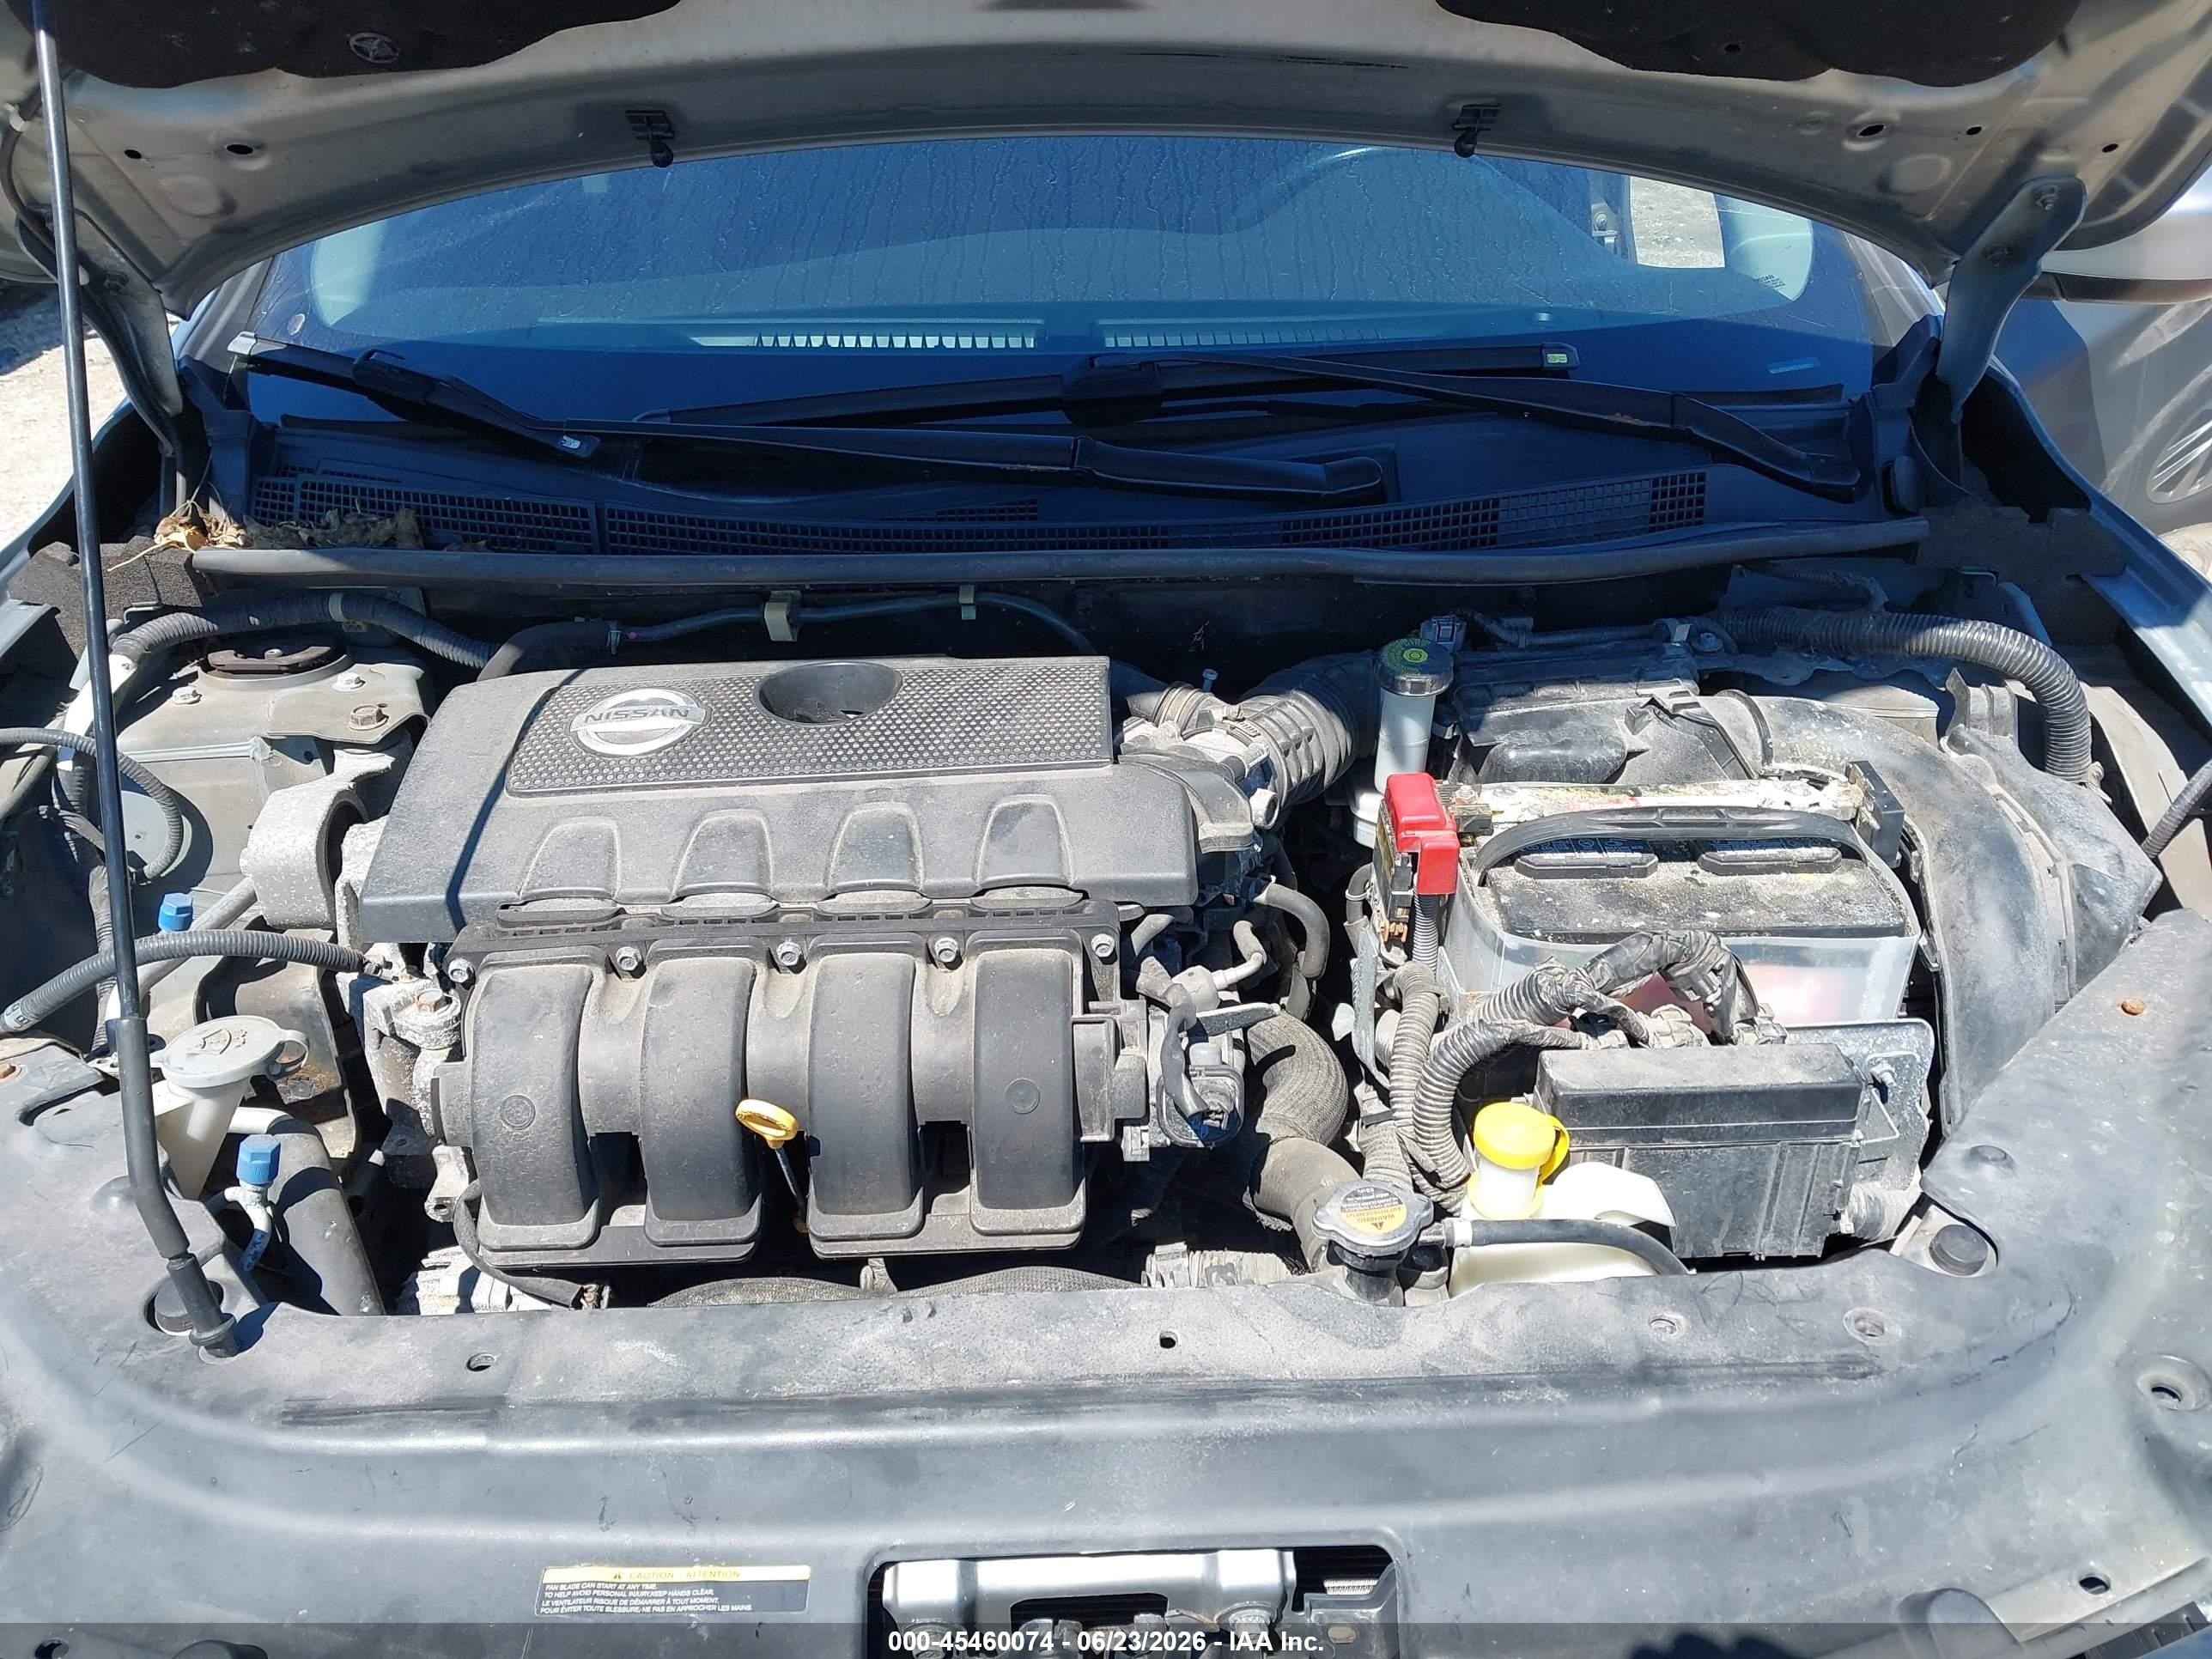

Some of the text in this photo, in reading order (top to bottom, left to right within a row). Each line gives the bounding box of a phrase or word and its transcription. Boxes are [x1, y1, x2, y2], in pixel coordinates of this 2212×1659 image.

[585, 708, 690, 723] NISSAN
[629, 1570, 740, 1580] CAUTION ATTENTION
[550, 1598, 592, 1607] VENTILATEUR
